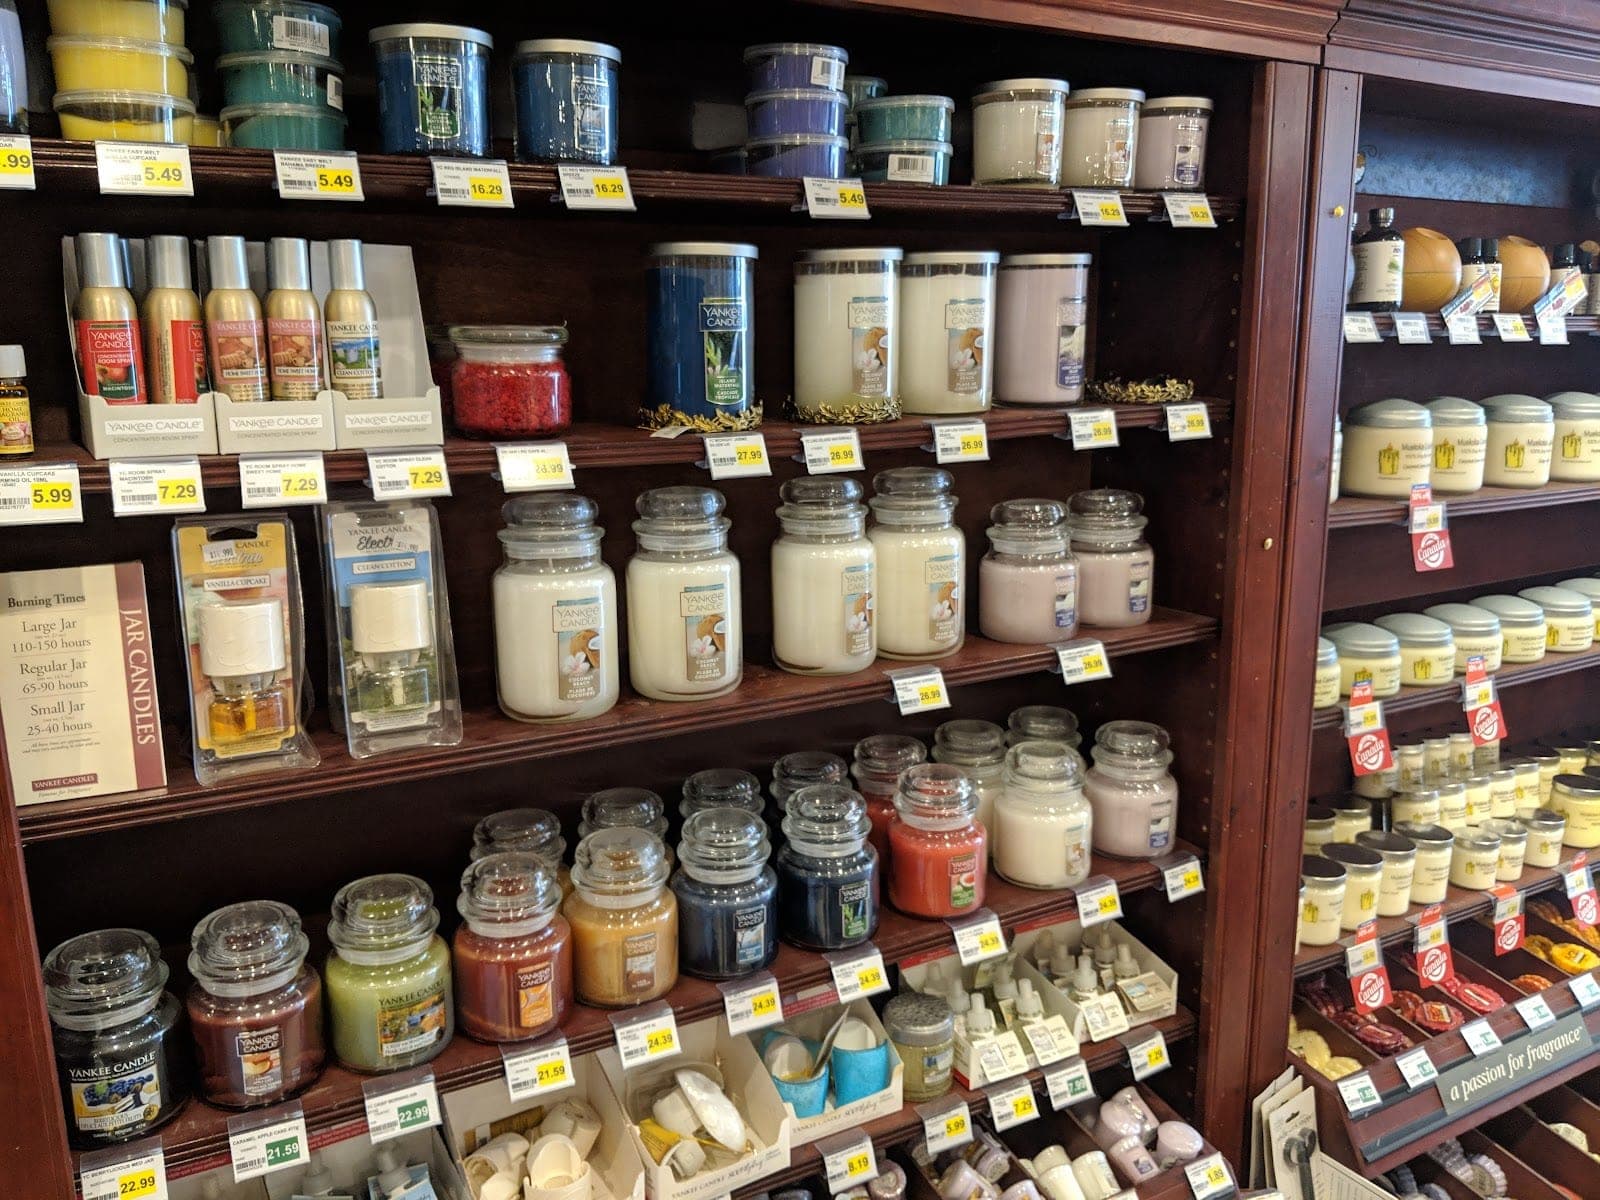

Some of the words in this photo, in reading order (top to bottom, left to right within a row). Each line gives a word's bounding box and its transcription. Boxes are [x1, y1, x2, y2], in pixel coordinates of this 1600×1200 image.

[144, 167, 182, 183] 5.49
[319, 174, 353, 188] 5.49
[472, 183, 502, 196] 16.29
[596, 183, 624, 194] 16.29
[840, 193, 864, 205] 5.49
[108, 422, 154, 433] YANKEE
[154, 420, 200, 430] CANDLE
[232, 419, 276, 429] YANKEE
[277, 417, 320, 426] CANDLE
[348, 416, 389, 426] YANKEE
[113, 435, 161, 443] CONCENTRATED
[237, 431, 282, 439] CONCENTRATED
[962, 441, 983, 450] 26.99
[737, 451, 762, 460] 27.99
[830, 450, 854, 460] 26.99
[410, 471, 442, 485] 7.29
[159, 485, 196, 500] 7.29
[283, 479, 318, 492] 7.29
[33, 488, 72, 503] 5.99
[348, 527, 381, 536] YANKEE
[1417, 541, 1446, 562] Canada
[357, 563, 379, 572] CLEAN
[379, 562, 412, 571] COTTON
[206, 578, 237, 588] VANILLA
[236, 576, 269, 586] CUPCAKE
[8, 596, 53, 610] Burning
[53, 593, 86, 605] Times
[684, 593, 725, 604] YANKEE
[557, 606, 600, 618] YANKEE
[688, 602, 722, 612] CANDLE
[22, 620, 57, 635] Large
[60, 618, 78, 632] Jar
[119, 608, 145, 647] JAR
[560, 617, 599, 628] CANDLE
[12, 640, 58, 653] 110-150
[61, 637, 92, 650] hours
[20, 661, 69, 677] Regular
[70, 658, 88, 673] Jar
[1084, 660, 1103, 670] 26.99
[22, 681, 56, 695] 65-90
[58, 679, 89, 691] hours
[128, 650, 156, 746] CANDLES
[920, 690, 941, 701] 26.99
[30, 702, 66, 717] Small
[68, 700, 86, 715] Jar
[26, 723, 60, 737] 25-40
[62, 720, 93, 732] hours
[1355, 739, 1385, 765] Canada
[34, 778, 62, 790] YANKEE
[62, 774, 96, 786] CANDLES
[859, 973, 881, 984] 24.39
[378, 994, 415, 1007] YANKEE
[415, 978, 445, 1000] CANDLE
[1358, 978, 1385, 1004] Canada
[753, 999, 776, 1012] 24.39
[240, 1032, 280, 1046] YANKEE
[648, 1034, 673, 1049] 24.39
[243, 1041, 279, 1053] CANDLE
[69, 1068, 112, 1079] YANKEE
[113, 1051, 157, 1075] CANDLE
[1449, 1086, 1460, 1100] a
[1462, 1065, 1507, 1101] passion
[1507, 1052, 1526, 1078] for
[1525, 1031, 1583, 1070] fragrance
[539, 1066, 565, 1081] 21.59
[1014, 1100, 1032, 1113] 7.29
[399, 1106, 429, 1123] 22.99
[947, 1119, 966, 1133] 5.99
[233, 1136, 256, 1146] CARAMEL
[257, 1131, 273, 1140] APPLE
[267, 1143, 299, 1160] 21.59
[90, 1164, 130, 1180] BERRYLICIOUS
[144, 1158, 155, 1166] JAR
[848, 1157, 869, 1172] 8.19
[120, 1176, 155, 1194] 22.99
